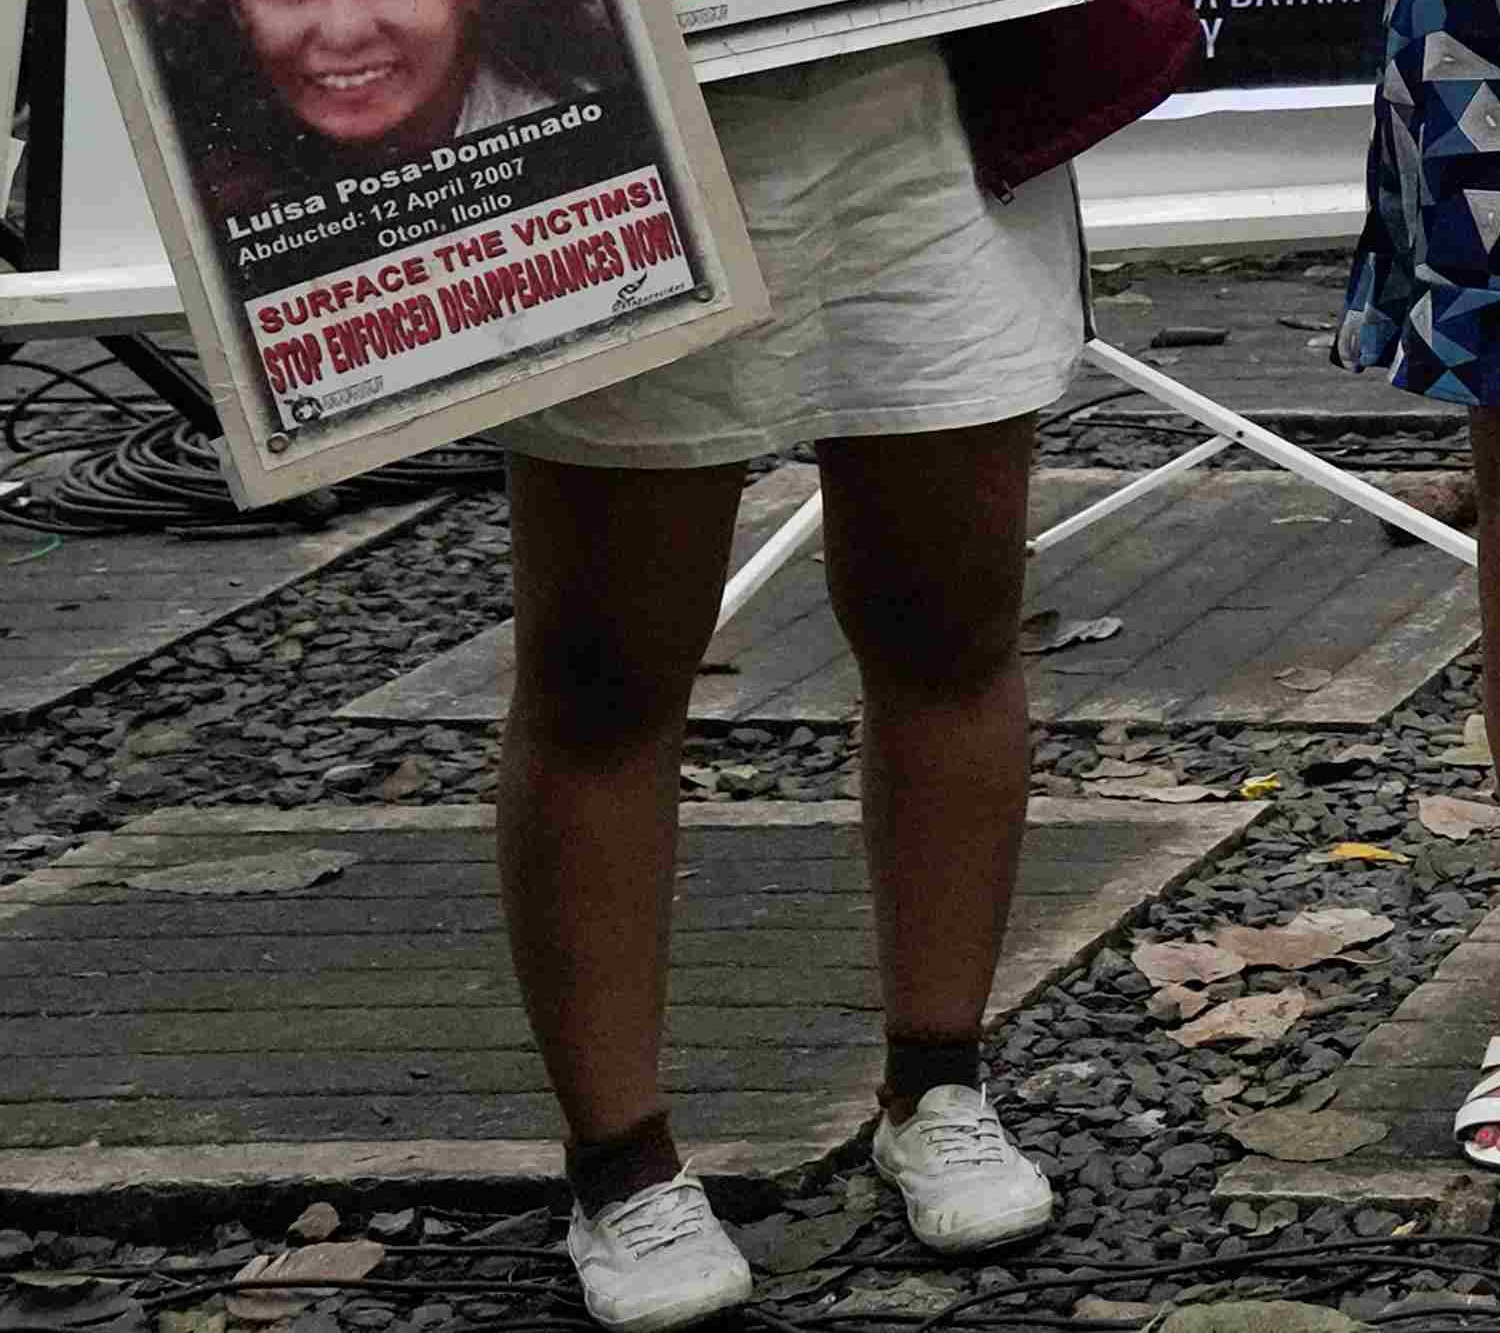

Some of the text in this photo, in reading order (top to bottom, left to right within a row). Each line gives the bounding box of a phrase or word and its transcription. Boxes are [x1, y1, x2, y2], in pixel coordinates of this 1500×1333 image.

[225, 102, 603, 241] Luisa Posa-Dominado
[238, 157, 525, 266] Abducted: 12 April 2007
[377, 193, 513, 249] Oton, Iloilo
[257, 176, 664, 334] SURFACE THE VICTIMS!
[262, 332, 323, 395] STOP
[321, 292, 442, 375] ENFORCED
[437, 230, 625, 335] DISAPPEARANCES
[618, 211, 682, 272] NOW!
